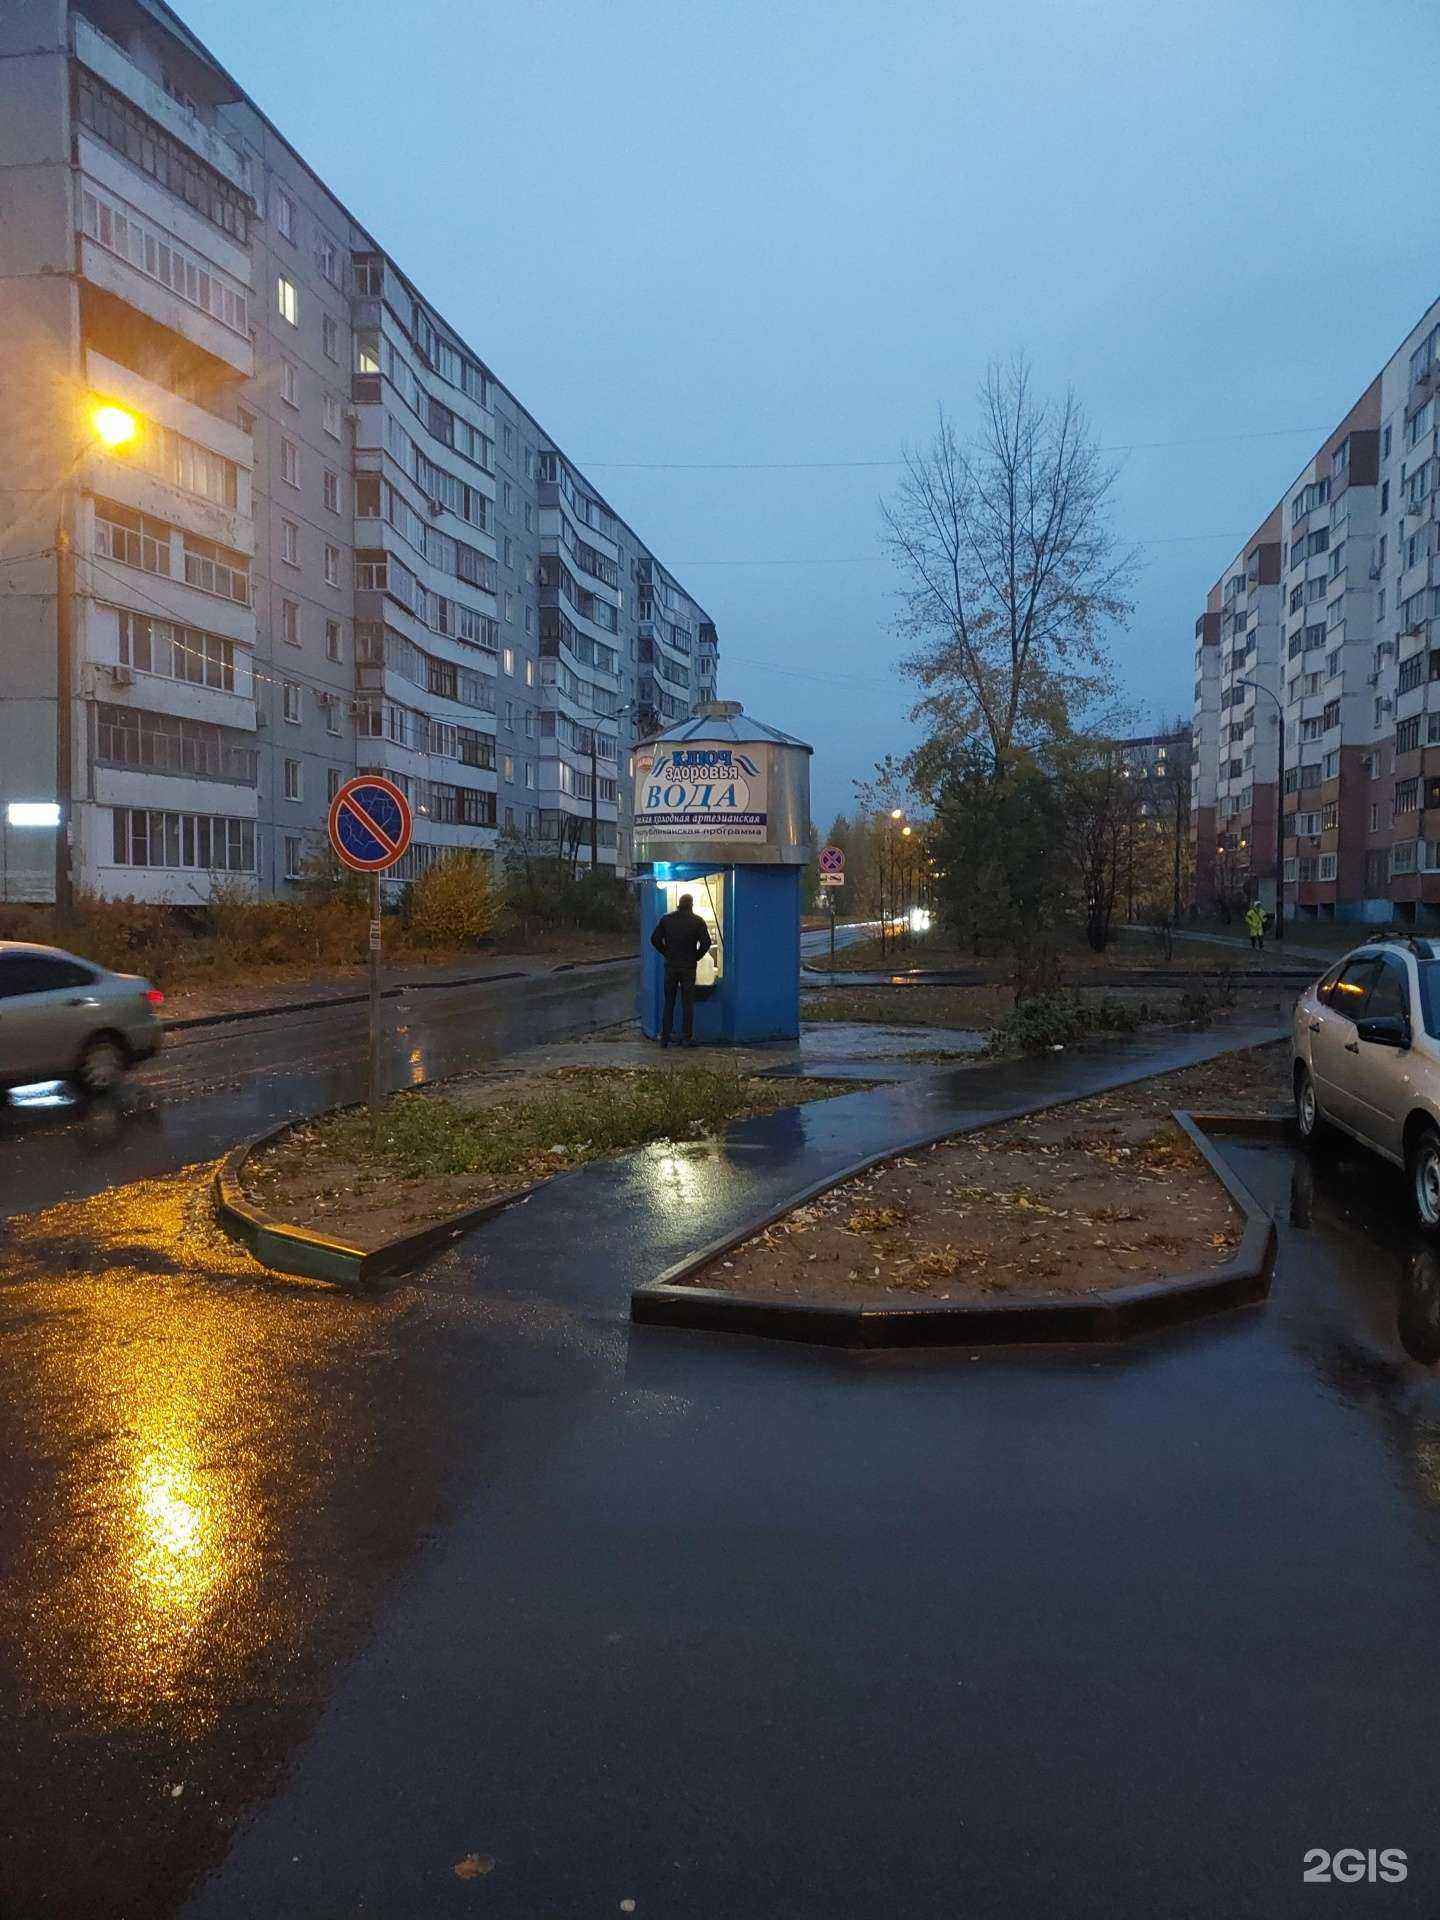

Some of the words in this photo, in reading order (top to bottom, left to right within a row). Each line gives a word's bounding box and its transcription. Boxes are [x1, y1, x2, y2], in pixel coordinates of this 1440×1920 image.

[646, 783, 738, 811] ВОДА
[692, 814, 760, 824] артезианская
[703, 828, 761, 836] программа
